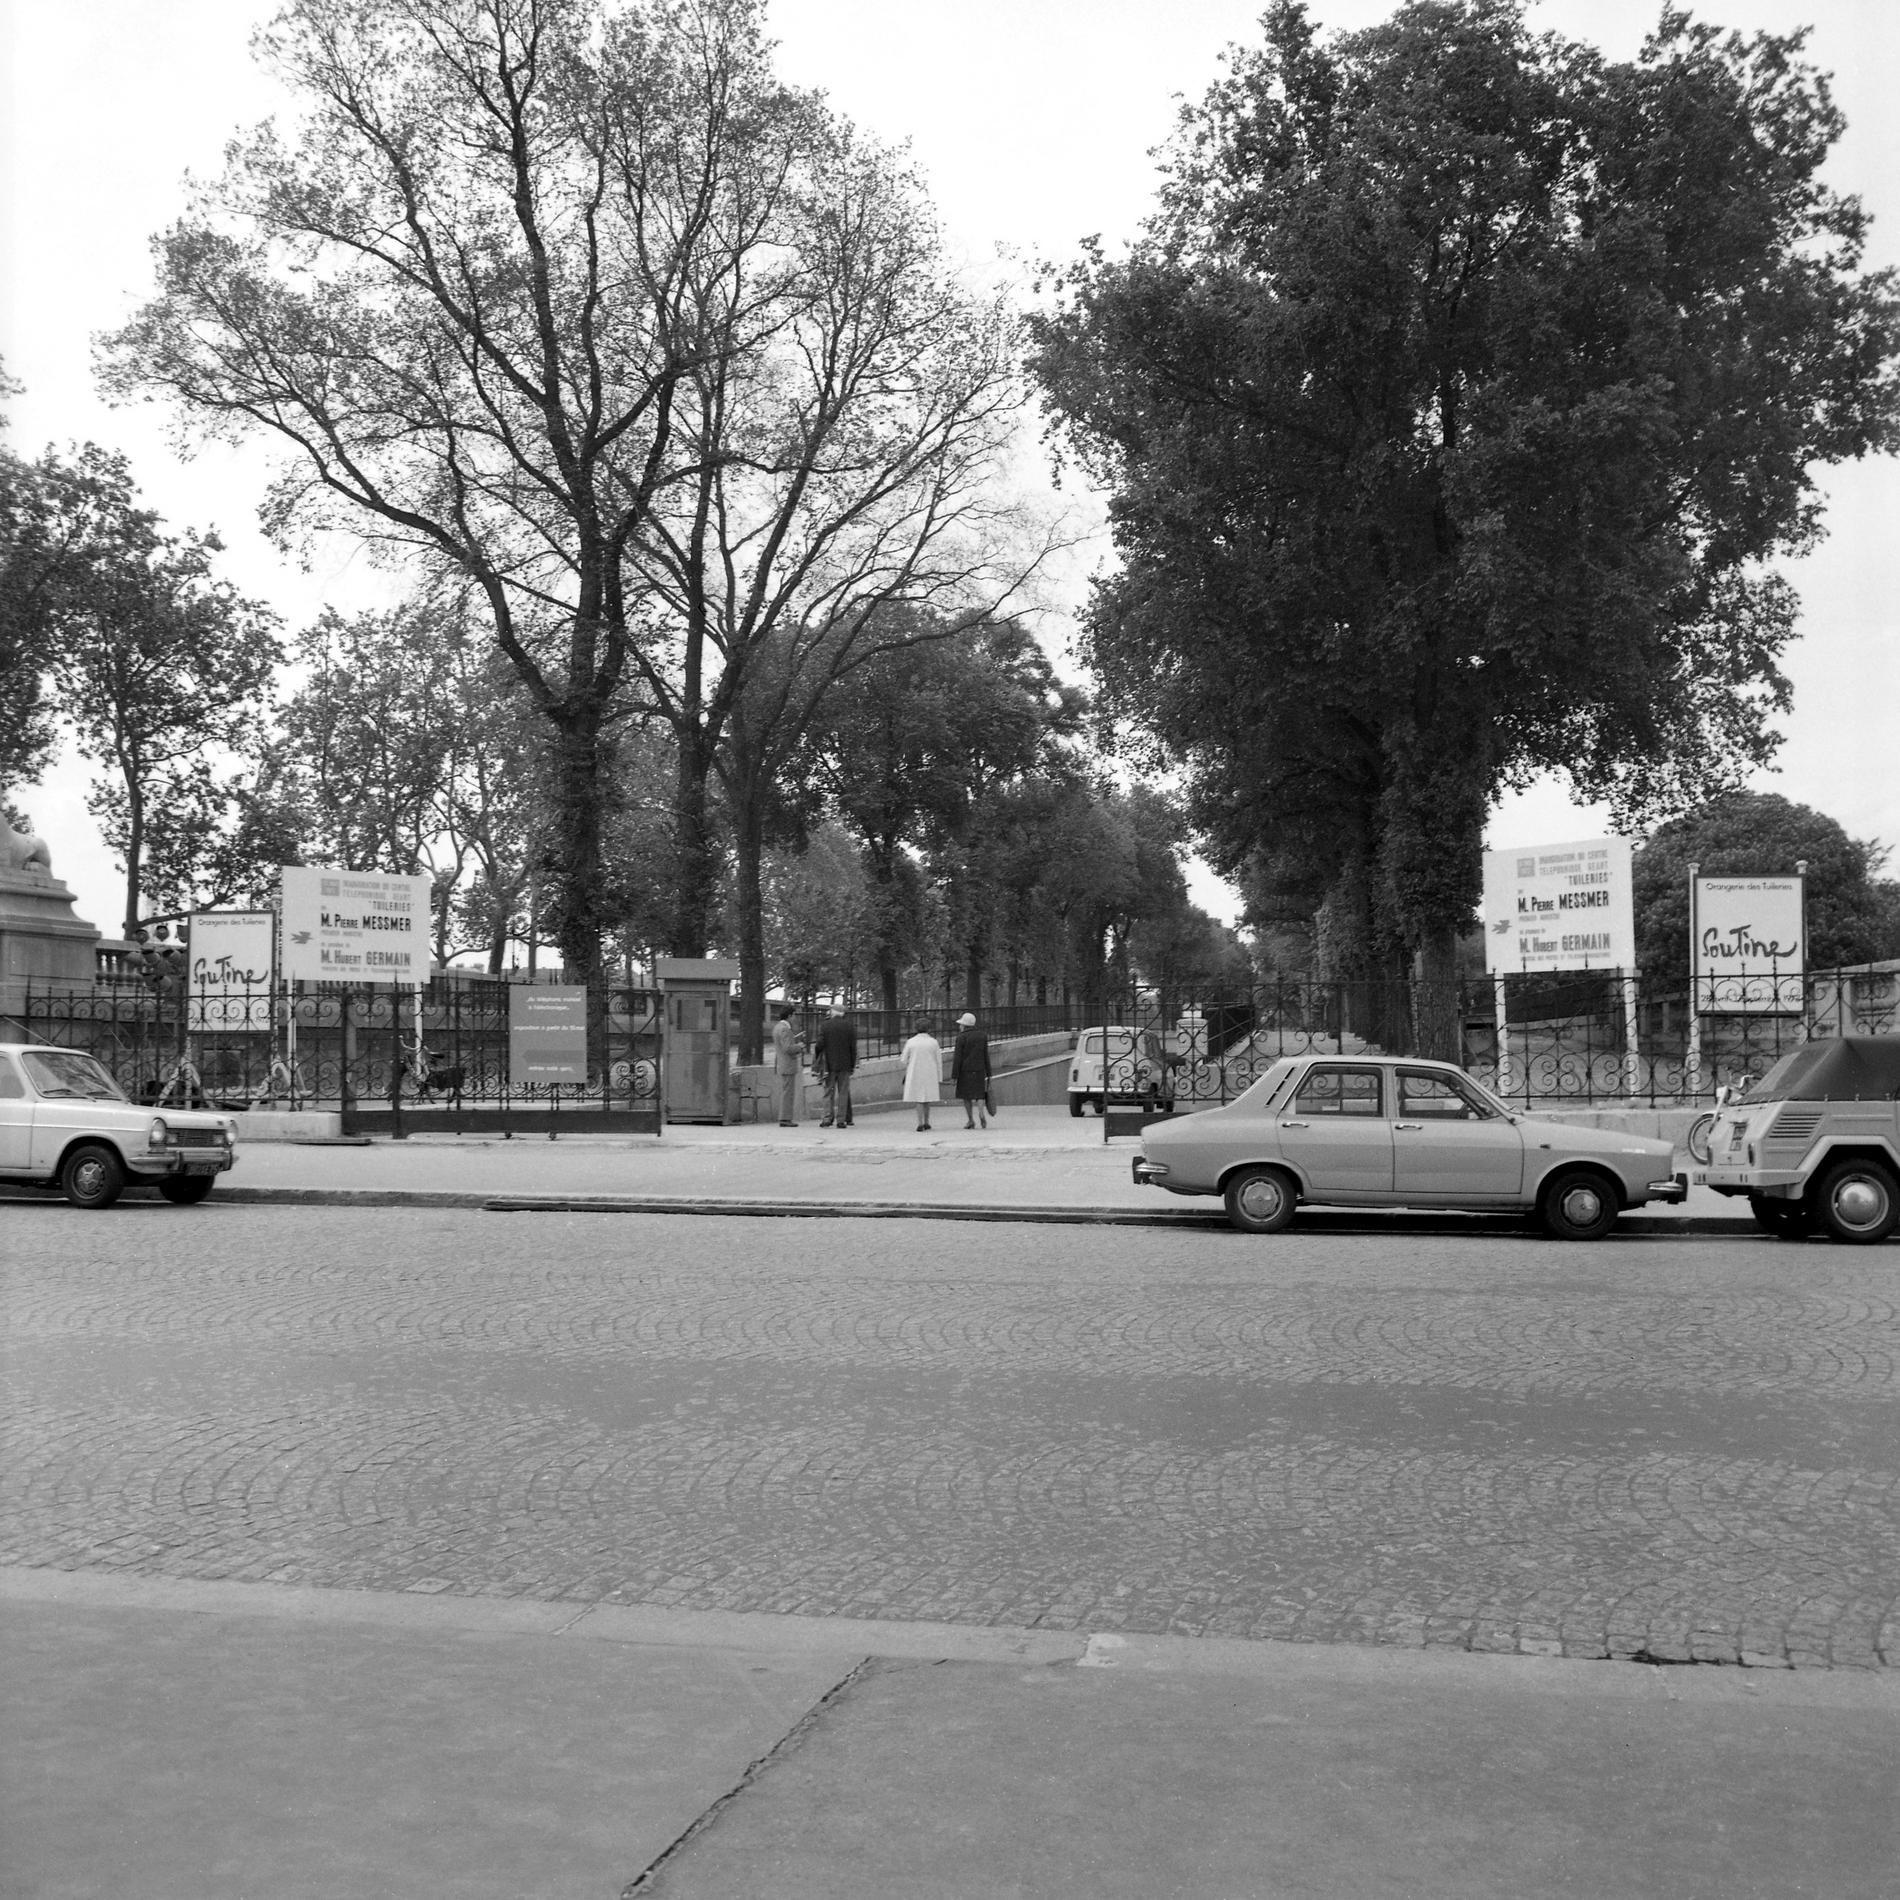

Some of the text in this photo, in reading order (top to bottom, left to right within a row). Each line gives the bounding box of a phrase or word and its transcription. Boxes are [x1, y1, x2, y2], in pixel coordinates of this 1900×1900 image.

[1705, 882, 1745, 892] Orangerie
[1762, 882, 1793, 890] Tuileries
[1518, 897, 1529, 913] M.
[1559, 890, 1609, 910] MESSMER
[321, 912, 333, 928] M.
[362, 915, 411, 931] MESSMER
[1519, 937, 1531, 953] M.
[1562, 933, 1610, 951] GERMAIN
[321, 949, 333, 964] M.
[366, 951, 411, 966] GERMAIN
